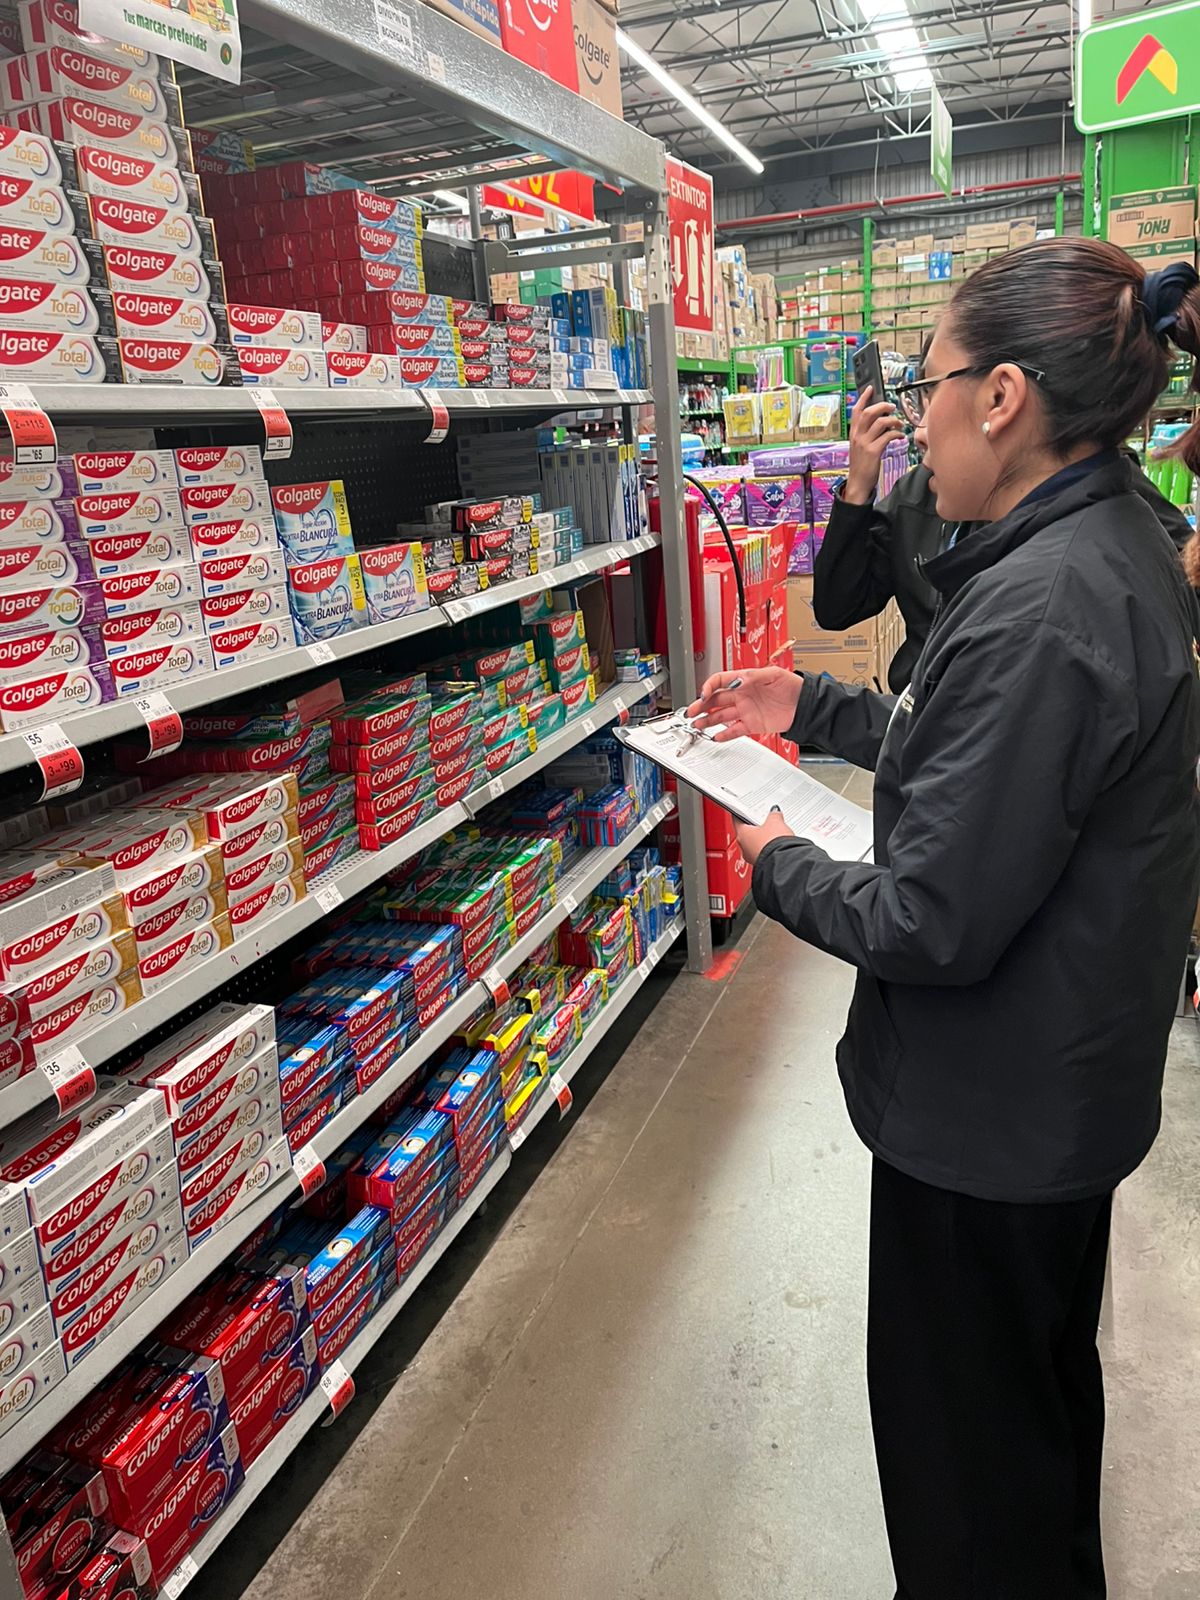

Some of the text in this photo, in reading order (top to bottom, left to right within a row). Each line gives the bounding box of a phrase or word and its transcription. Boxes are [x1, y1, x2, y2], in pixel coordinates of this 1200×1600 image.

[124, 10, 136, 26] Tus
[136, 14, 167, 41] marcas
[168, 22, 208, 52] preferidas
[574, 24, 611, 69] Colgate
[60, 52, 121, 84] Colgate
[139, 130, 163, 147] Total
[14, 145, 43, 161] Total
[358, 193, 392, 214] Colgate
[670, 176, 707, 210] EXTINTOR
[28, 196, 56, 213] Total
[99, 202, 157, 226] Colgate
[40, 247, 72, 264] Total
[366, 262, 397, 281] Colgate
[50, 299, 82, 314] Total
[116, 296, 174, 317] Colgate
[506, 306, 529, 316] Colgate
[282, 320, 300, 334] Total
[0, 333, 49, 355] lgate
[462, 344, 485, 353] Colgate
[193, 358, 216, 370] Total
[331, 352, 367, 369] Colgate
[402, 358, 434, 375] Colgate
[512, 371, 531, 379] Colgate
[14, 420, 20, 430] 2
[32, 449, 43, 460] $65
[78, 454, 127, 472] Colgate
[180, 451, 221, 465] Colgate
[231, 493, 250, 505] Total
[276, 486, 322, 506] Colgate
[766, 490, 785, 503] Saba
[340, 504, 345, 515] 3
[20, 516, 48, 528] Total
[300, 528, 338, 543] BLANCURA
[484, 531, 508, 546] Colgate
[146, 540, 168, 554] Total
[204, 558, 244, 575] Colgate
[364, 550, 403, 569] Colgate
[416, 563, 422, 574] 3
[294, 564, 338, 585] Colgate
[354, 578, 360, 589] 3
[428, 574, 453, 588] Colgate
[384, 586, 416, 601] BLANCURA
[48, 602, 77, 614] Total
[317, 602, 354, 620] BLANCURA
[215, 629, 255, 647] Colgate
[116, 652, 165, 672] Colgate
[480, 652, 507, 671] Colgate
[556, 652, 578, 668] Colgate
[2, 681, 58, 704] Colgate
[136, 699, 150, 711] $35
[184, 718, 237, 731] Colgate
[371, 706, 410, 732] Colgate
[434, 706, 466, 729] Colgate
[26, 732, 42, 746] $55
[154, 725, 177, 740] 3 $99
[252, 736, 302, 764] Colgate
[486, 744, 511, 764] Colgate
[48, 760, 76, 777] 3 $99
[372, 758, 411, 786] Colgate
[438, 776, 470, 801] Colgate
[226, 792, 263, 819] Colgate
[302, 817, 331, 843] lgate
[380, 808, 417, 837] Colgate
[163, 834, 184, 851] Total
[513, 862, 537, 884] Colgate
[270, 890, 287, 906] Total
[465, 896, 489, 923] Colgate
[138, 904, 183, 938] Colgate
[602, 920, 622, 943] Colgate
[11, 921, 70, 959] Colgate
[83, 958, 109, 977] Total
[414, 946, 443, 980] Colgate
[470, 948, 494, 974] Colgate
[30, 1001, 84, 1039] Colgate
[356, 1018, 391, 1056] Colgate
[548, 1024, 571, 1052] Colgate
[232, 1038, 253, 1058] Total
[44, 1062, 60, 1075] $35
[282, 1055, 321, 1097] Colgate
[64, 1095, 71, 1106] 3
[178, 1084, 229, 1132] Colgate
[458, 1082, 483, 1119] Colgate
[85, 1108, 115, 1130] Total
[8, 1129, 76, 1180] Colgate
[239, 1139, 259, 1161] Total
[118, 1159, 143, 1184] Total
[396, 1152, 431, 1194] Colgate
[459, 1154, 488, 1194] Colgate
[47, 1176, 112, 1236] Colgate
[187, 1180, 239, 1232] Colgate
[128, 1234, 152, 1259] Total
[400, 1224, 436, 1270] Colgate
[312, 1250, 360, 1304] Colgate
[68, 1283, 129, 1345] Colgate
[200, 1312, 235, 1350] Colgate
[322, 1302, 367, 1360] Colgate
[166, 1378, 186, 1398] WHITE
[213, 1376, 219, 1389] 2
[235, 1360, 285, 1426] Colgate
[102, 1416, 142, 1458] Colgate
[185, 1423, 207, 1448] WHITE
[228, 1438, 234, 1449] 2
[144, 1467, 201, 1540] Colgate
[201, 1484, 221, 1509] WHITE
[20, 1516, 62, 1569] gate
[60, 1534, 87, 1559] WHITE
[88, 1559, 111, 1581] WHITE
